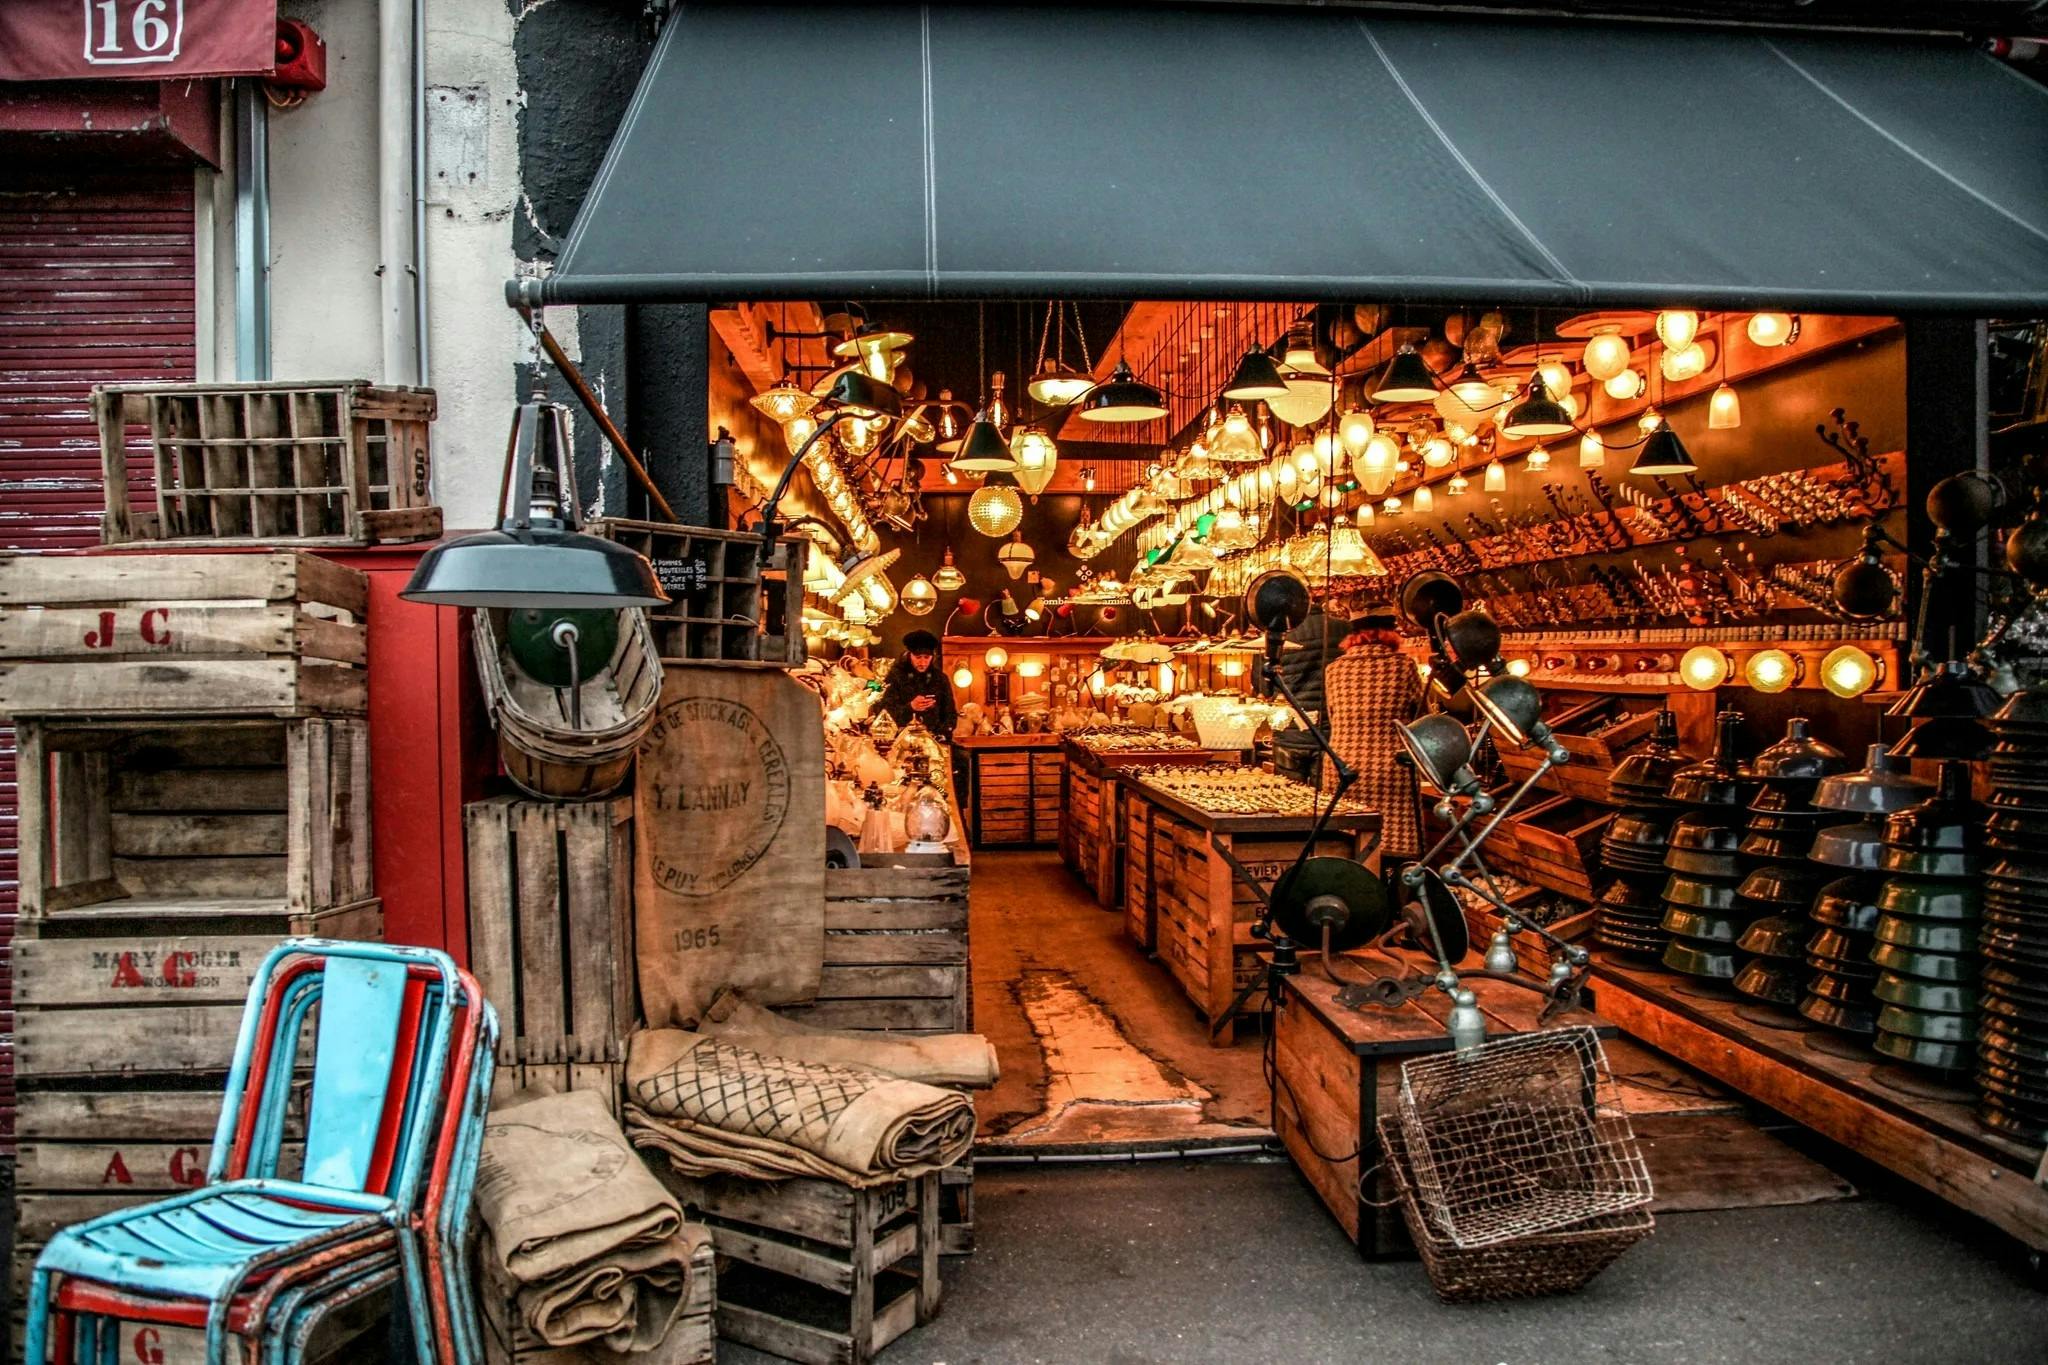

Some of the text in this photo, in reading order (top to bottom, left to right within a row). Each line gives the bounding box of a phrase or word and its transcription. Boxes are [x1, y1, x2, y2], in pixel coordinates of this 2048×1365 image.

[96, 0, 169, 52] 16
[84, 608, 171, 648] J C
[674, 923, 722, 953] 1965
[103, 1147, 206, 1188] A G
[133, 1327, 164, 1365] G
